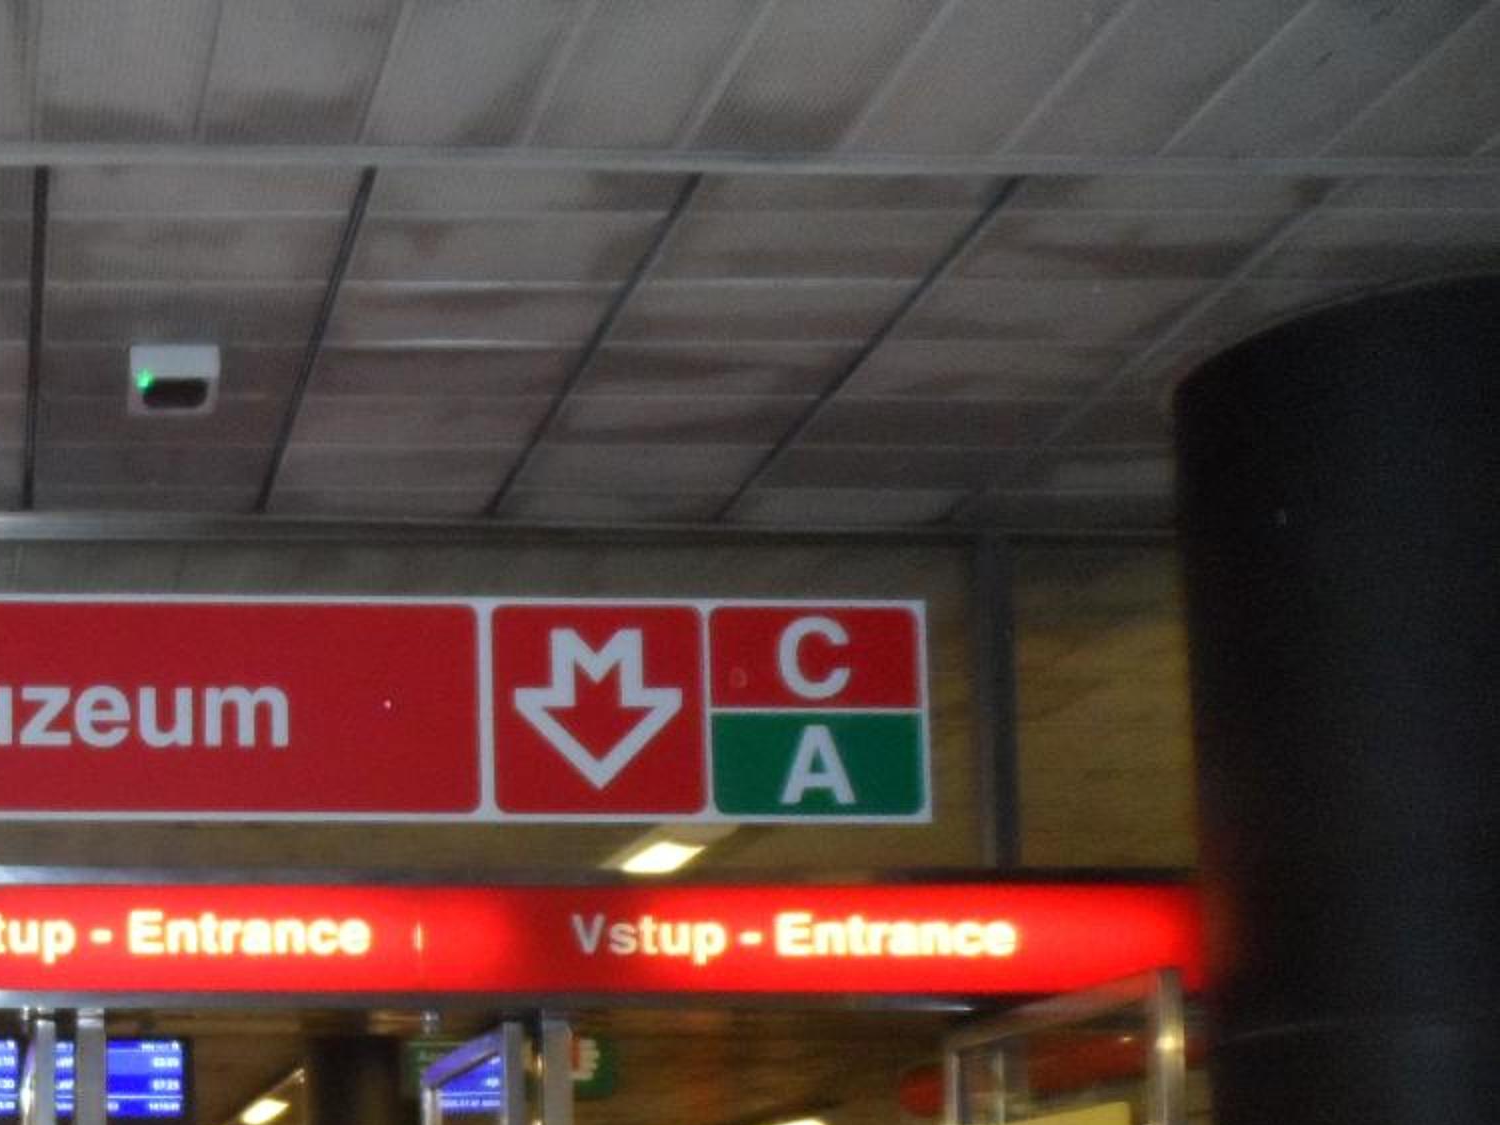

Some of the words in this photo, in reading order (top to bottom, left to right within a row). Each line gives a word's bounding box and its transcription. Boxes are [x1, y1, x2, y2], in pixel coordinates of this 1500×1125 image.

[776, 616, 851, 698] C
[780, 724, 855, 805] A
[127, 910, 371, 954] Entrance
[572, 912, 726, 966] Vstup
[774, 911, 1018, 956] Entrance
